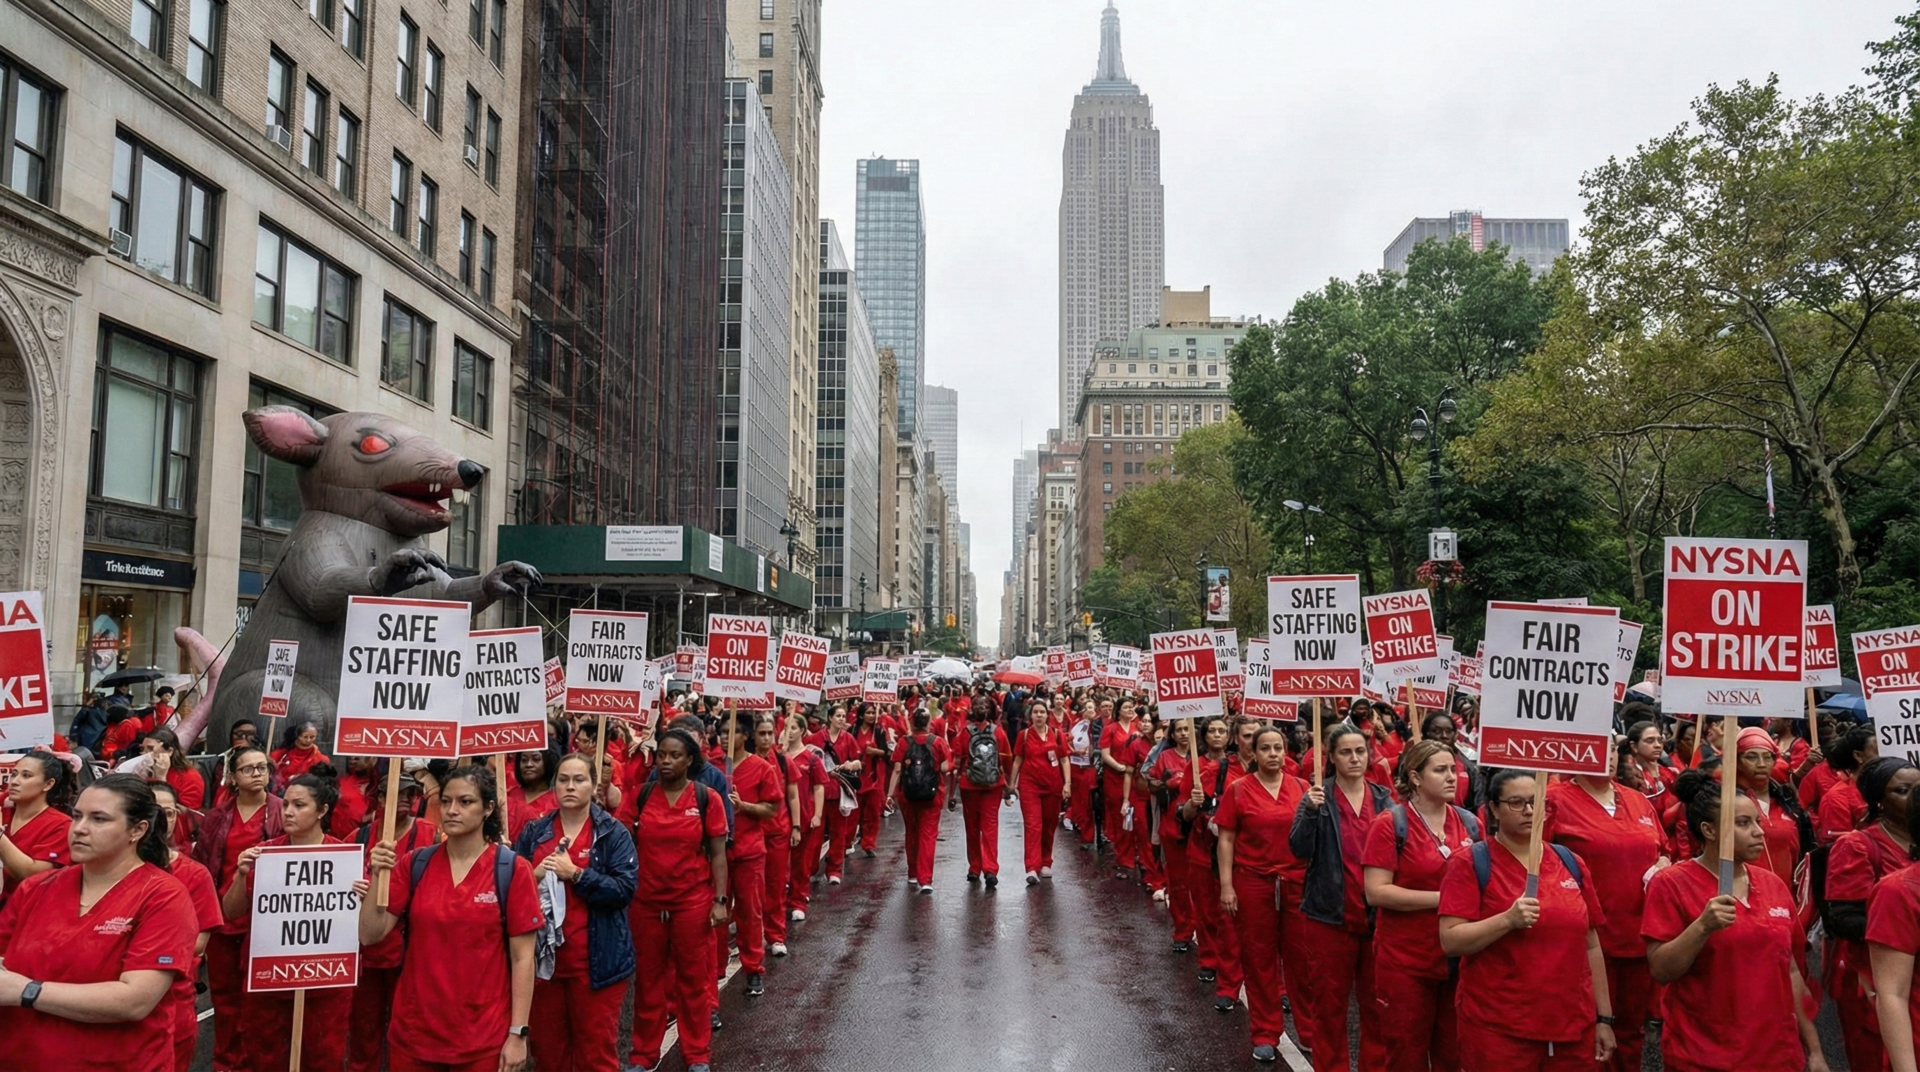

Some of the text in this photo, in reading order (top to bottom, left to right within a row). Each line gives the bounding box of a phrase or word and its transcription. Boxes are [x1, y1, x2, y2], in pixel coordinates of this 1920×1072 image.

[1670, 545, 1802, 576] NYSNA
[1291, 587, 1336, 608] SAFE
[1366, 593, 1428, 613] NYSNA
[1711, 588, 1760, 627] ON
[377, 613, 439, 643] SAFE
[591, 621, 626, 640] FAIR
[711, 617, 768, 633] NYSNA
[1272, 613, 1357, 635] STAFFING
[1388, 616, 1413, 635] ON
[726, 638, 749, 656] ON
[783, 633, 827, 652] NYSNA
[1153, 633, 1213, 650] NYSNA
[1522, 620, 1581, 653] FAIR
[1855, 629, 1920, 650] NYSNA
[476, 641, 518, 665] FAIR
[571, 643, 643, 661] CONTRACTS
[1294, 639, 1337, 661] NOW
[1373, 635, 1435, 660] STRIKE
[1671, 631, 1798, 672] STRIKE
[347, 646, 461, 677] STAFFING
[709, 657, 765, 677] STRIKE
[793, 652, 812, 668] ON
[1173, 654, 1197, 674] ON
[1489, 655, 1610, 686] CONTRACTS
[1880, 651, 1908, 671] ON
[463, 667, 541, 690] ONTRACTS
[588, 663, 624, 682] NOW
[778, 665, 822, 687] STRIKE
[1289, 675, 1355, 689] NYSNA
[372, 681, 431, 710] NOW
[1160, 674, 1217, 697] STRIKE
[477, 691, 520, 716] NOW
[581, 693, 635, 709] NYSNA
[1516, 689, 1579, 722] NOW
[1707, 689, 1762, 704] NYSNA
[360, 727, 449, 748] NYSNA
[474, 728, 539, 747] NYSNA
[1506, 738, 1599, 763] NYSNA
[285, 860, 334, 886] FAIR
[257, 891, 358, 914] CONTRACTS
[281, 918, 333, 946] NOW
[272, 961, 349, 980] NYSNA
